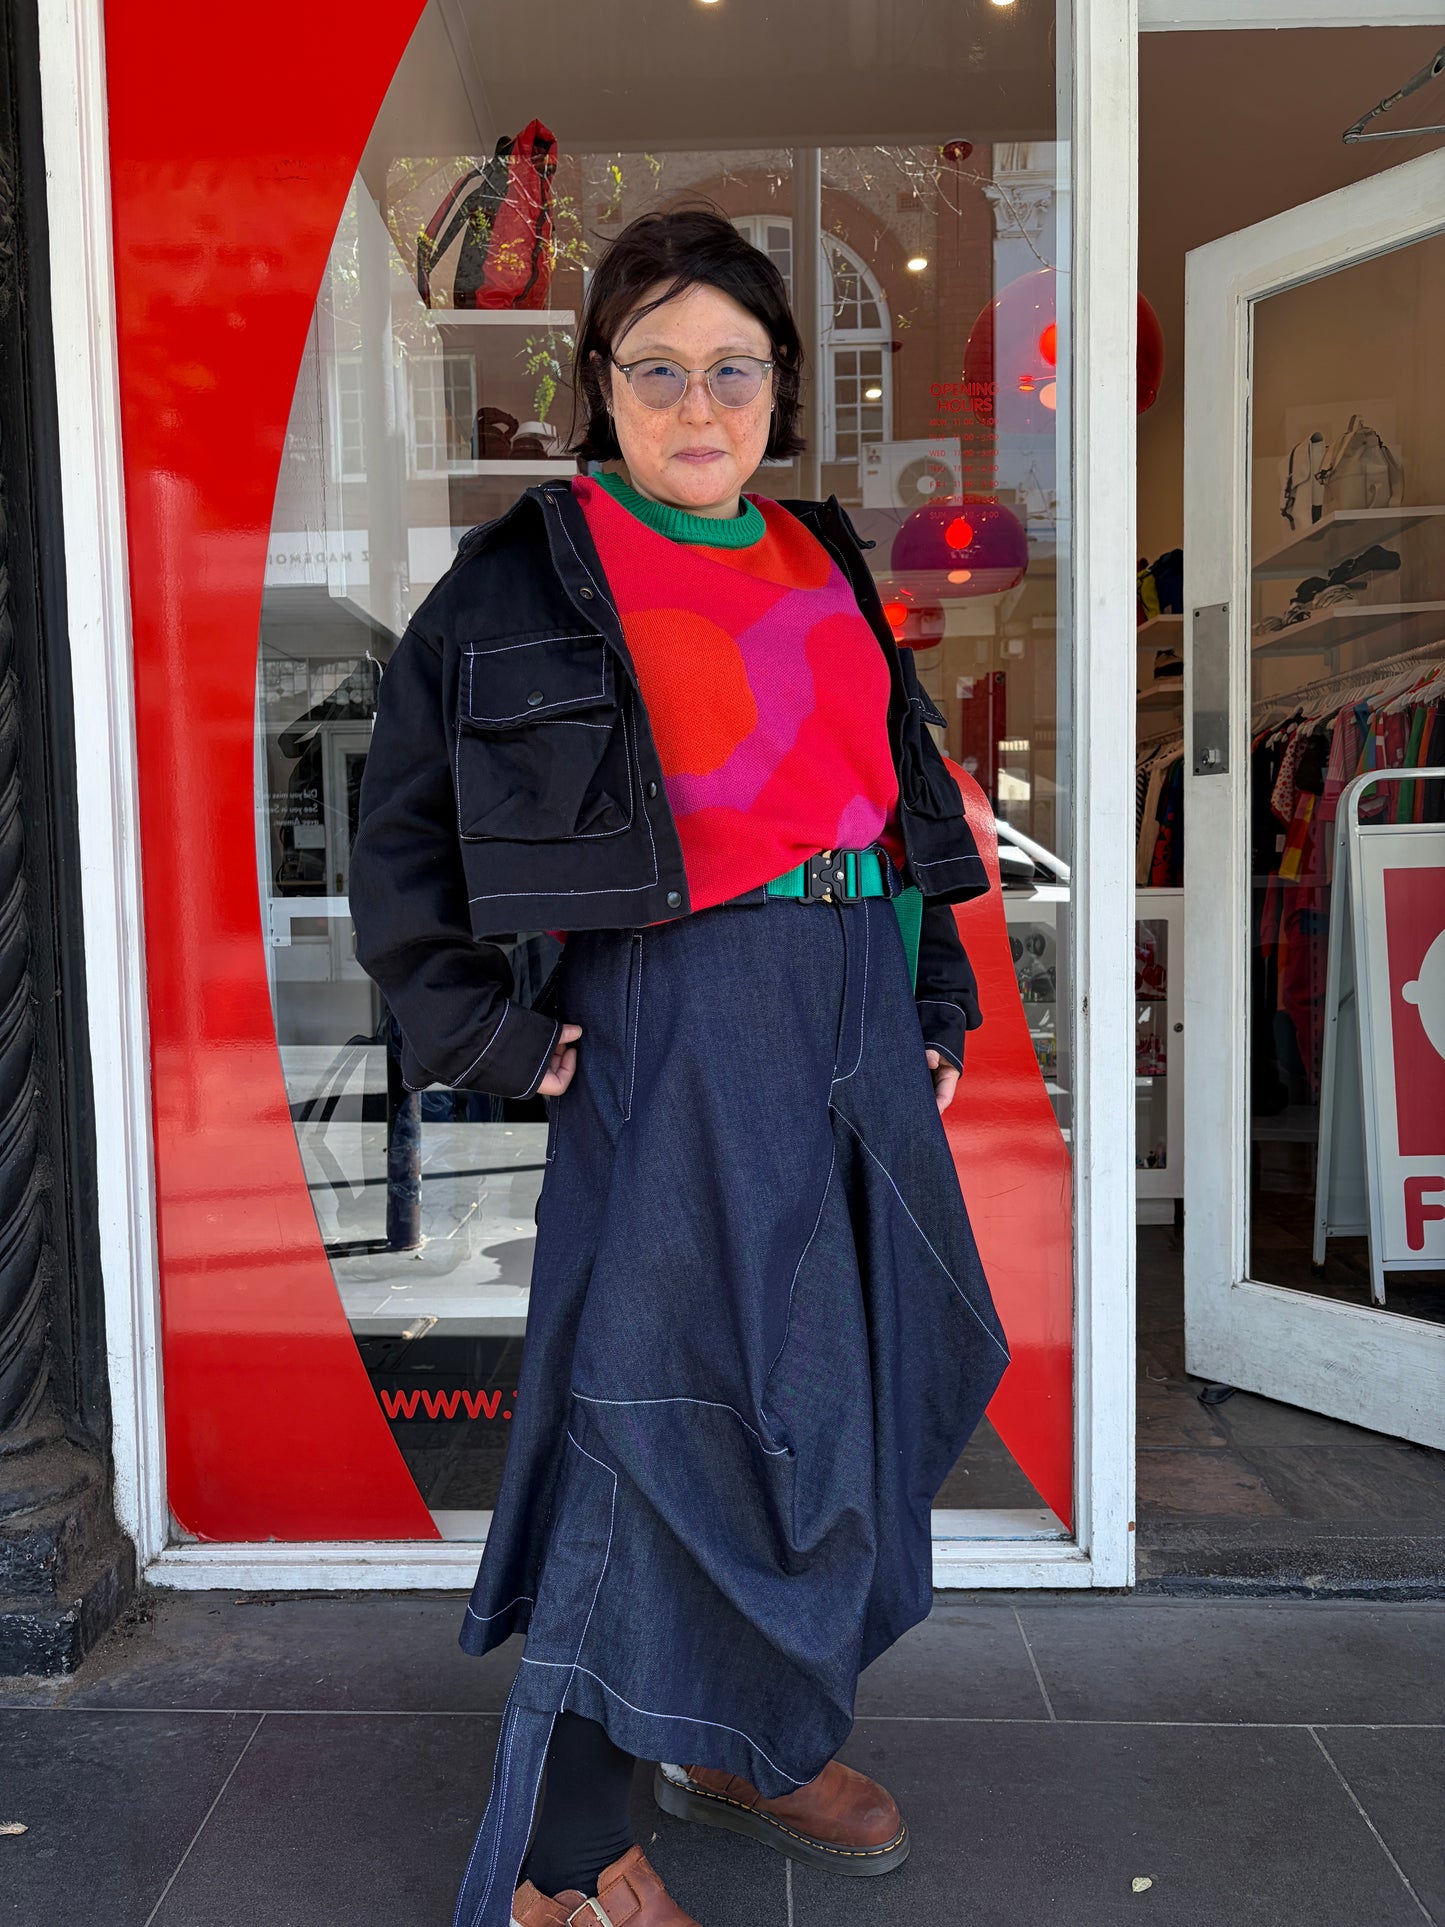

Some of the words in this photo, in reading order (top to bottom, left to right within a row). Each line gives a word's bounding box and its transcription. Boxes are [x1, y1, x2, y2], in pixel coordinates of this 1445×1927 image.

[929, 382, 1000, 397] OPENING
[937, 397, 993, 413] HOURS
[929, 418, 946, 426] MON
[929, 448, 946, 457] WED
[929, 464, 946, 472] THU
[929, 480, 946, 488] FRI
[1404, 1176, 1445, 1251] F
[380, 1390, 518, 1419] www.
